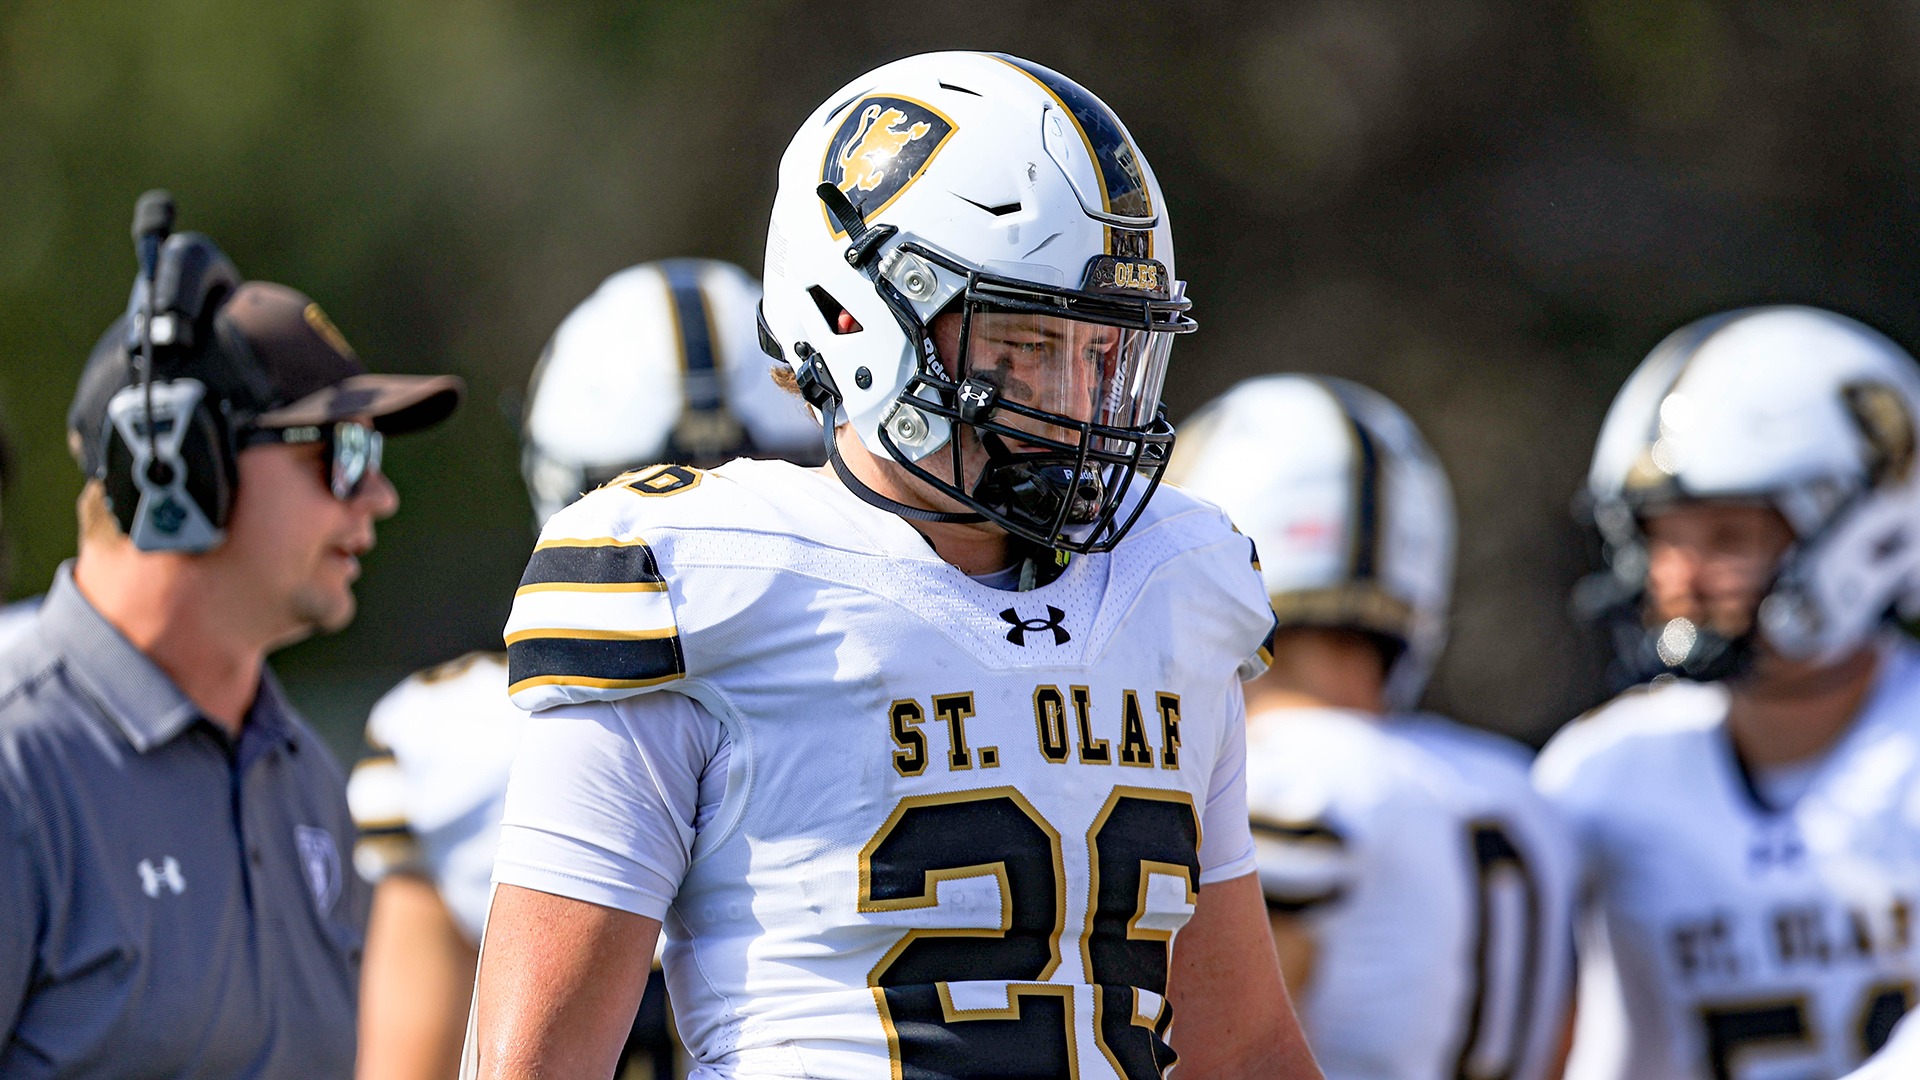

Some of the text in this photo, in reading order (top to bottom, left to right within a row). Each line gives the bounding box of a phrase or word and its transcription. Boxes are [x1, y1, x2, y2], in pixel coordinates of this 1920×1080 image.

[1114, 262, 1158, 290] OLES
[888, 684, 1182, 777] ST. OLAF
[857, 784, 1202, 1080] 26
